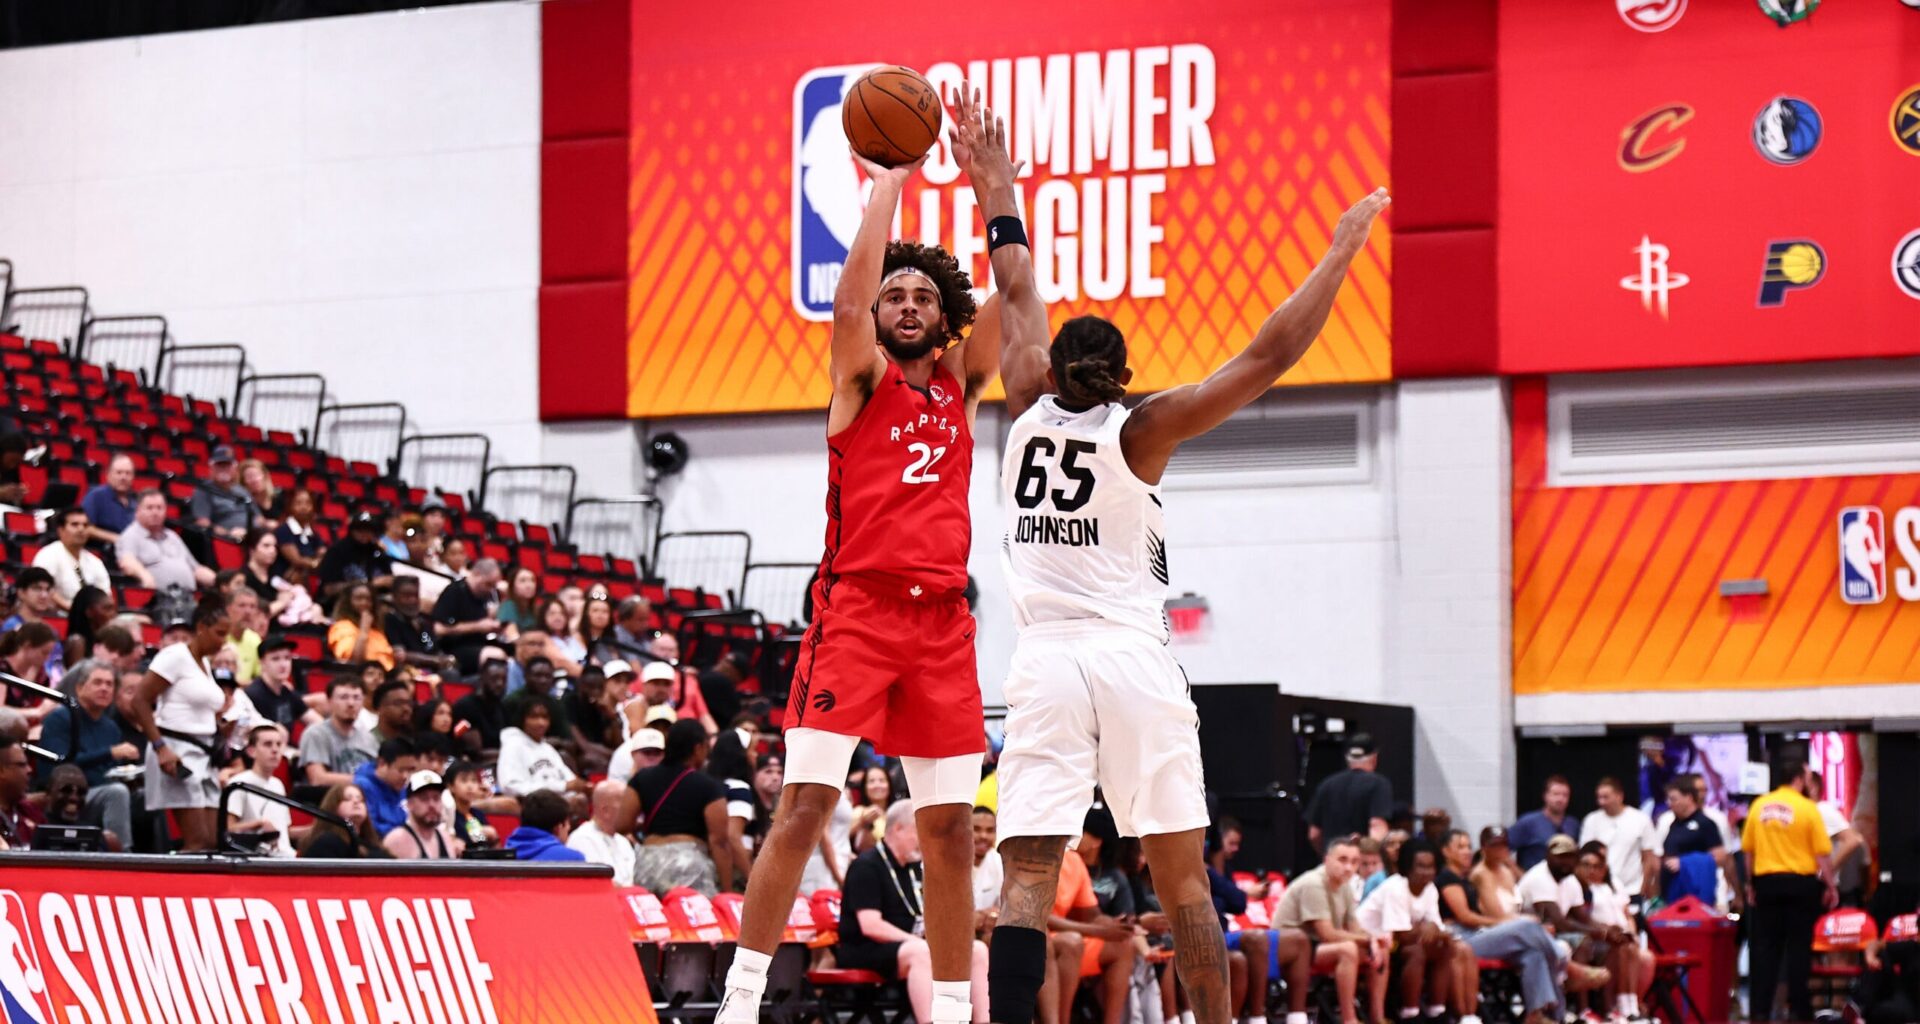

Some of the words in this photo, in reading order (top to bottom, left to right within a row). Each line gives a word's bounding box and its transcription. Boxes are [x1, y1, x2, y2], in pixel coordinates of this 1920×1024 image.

[808, 262, 843, 304] NB
[901, 442, 946, 484] 22
[1014, 436, 1096, 513] 65
[1014, 516, 1099, 547] JOHNSON
[38, 892, 313, 1024] SUMMER
[293, 897, 500, 1024] LEAGUE
